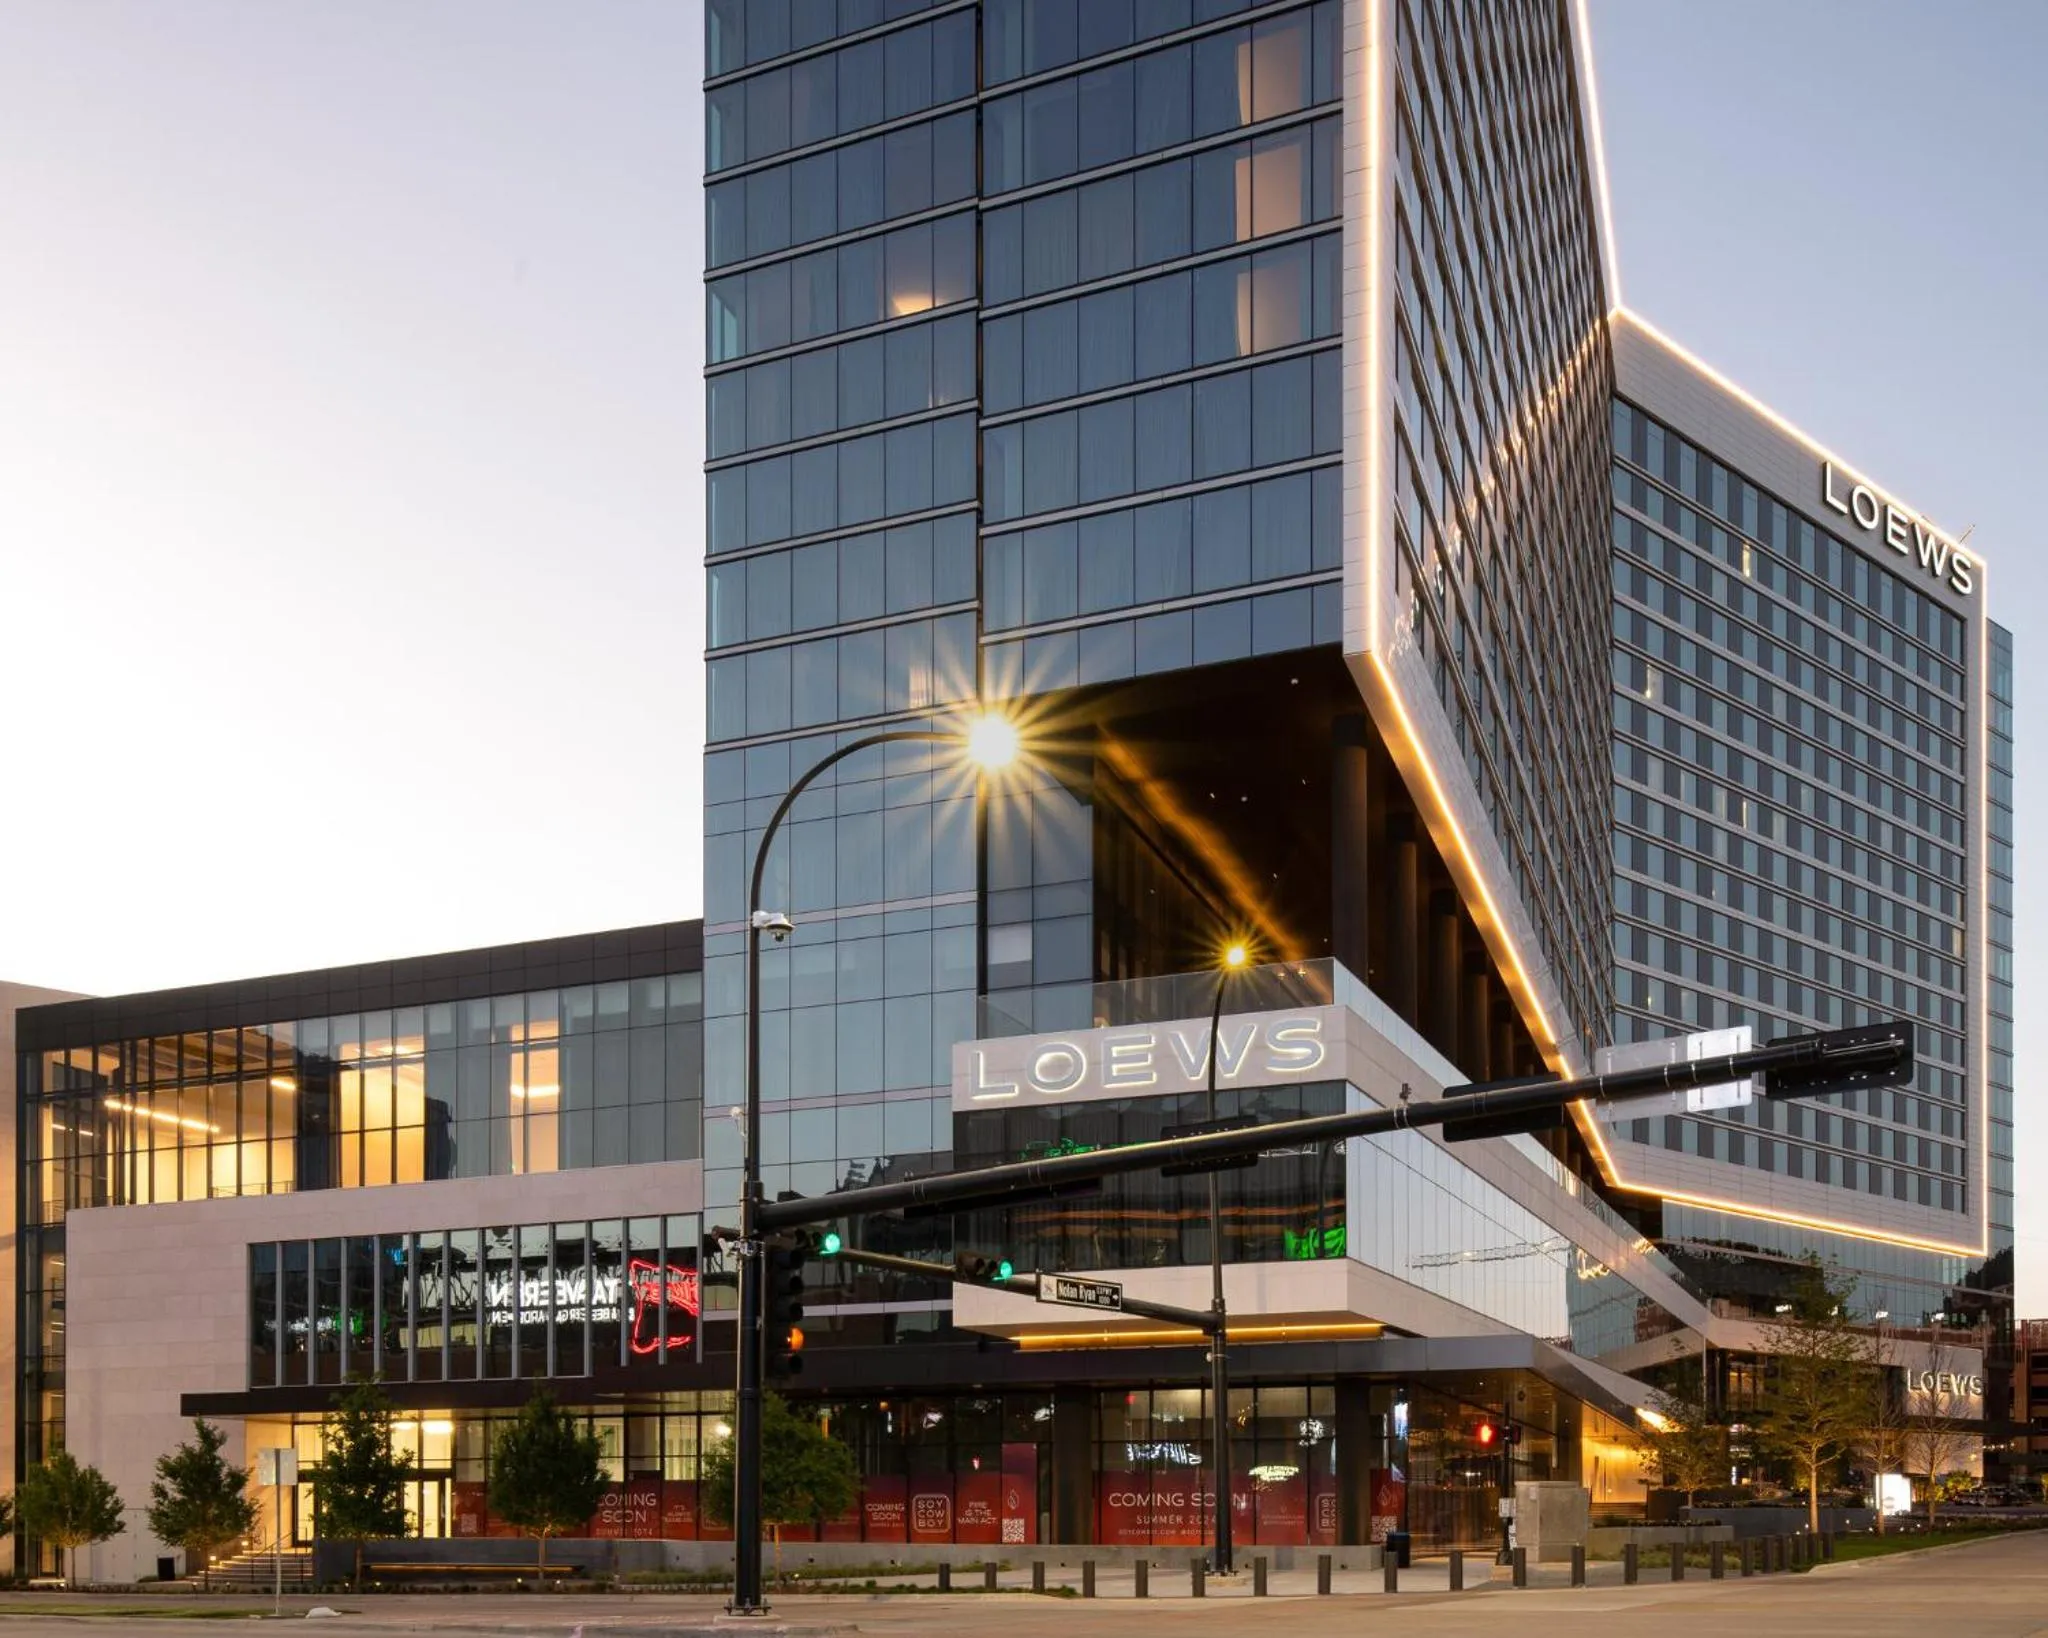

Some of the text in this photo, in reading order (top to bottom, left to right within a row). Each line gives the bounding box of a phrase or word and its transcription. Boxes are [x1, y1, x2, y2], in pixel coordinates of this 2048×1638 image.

[1823, 461, 1973, 595] LOEWS
[968, 1017, 1325, 1101] LOEWS
[1057, 1281, 1096, 1304] Nolan Ryan
[1907, 1369, 1982, 1396] LOEWS
[917, 1500, 943, 1509] SOY
[1109, 1492, 1246, 1508] COMING SON
[865, 1503, 905, 1512] COMING
[871, 1511, 901, 1521] SOON
[917, 1510, 945, 1519] COW
[1136, 1514, 1183, 1525] SUMMER
[918, 1519, 943, 1528] BOY
